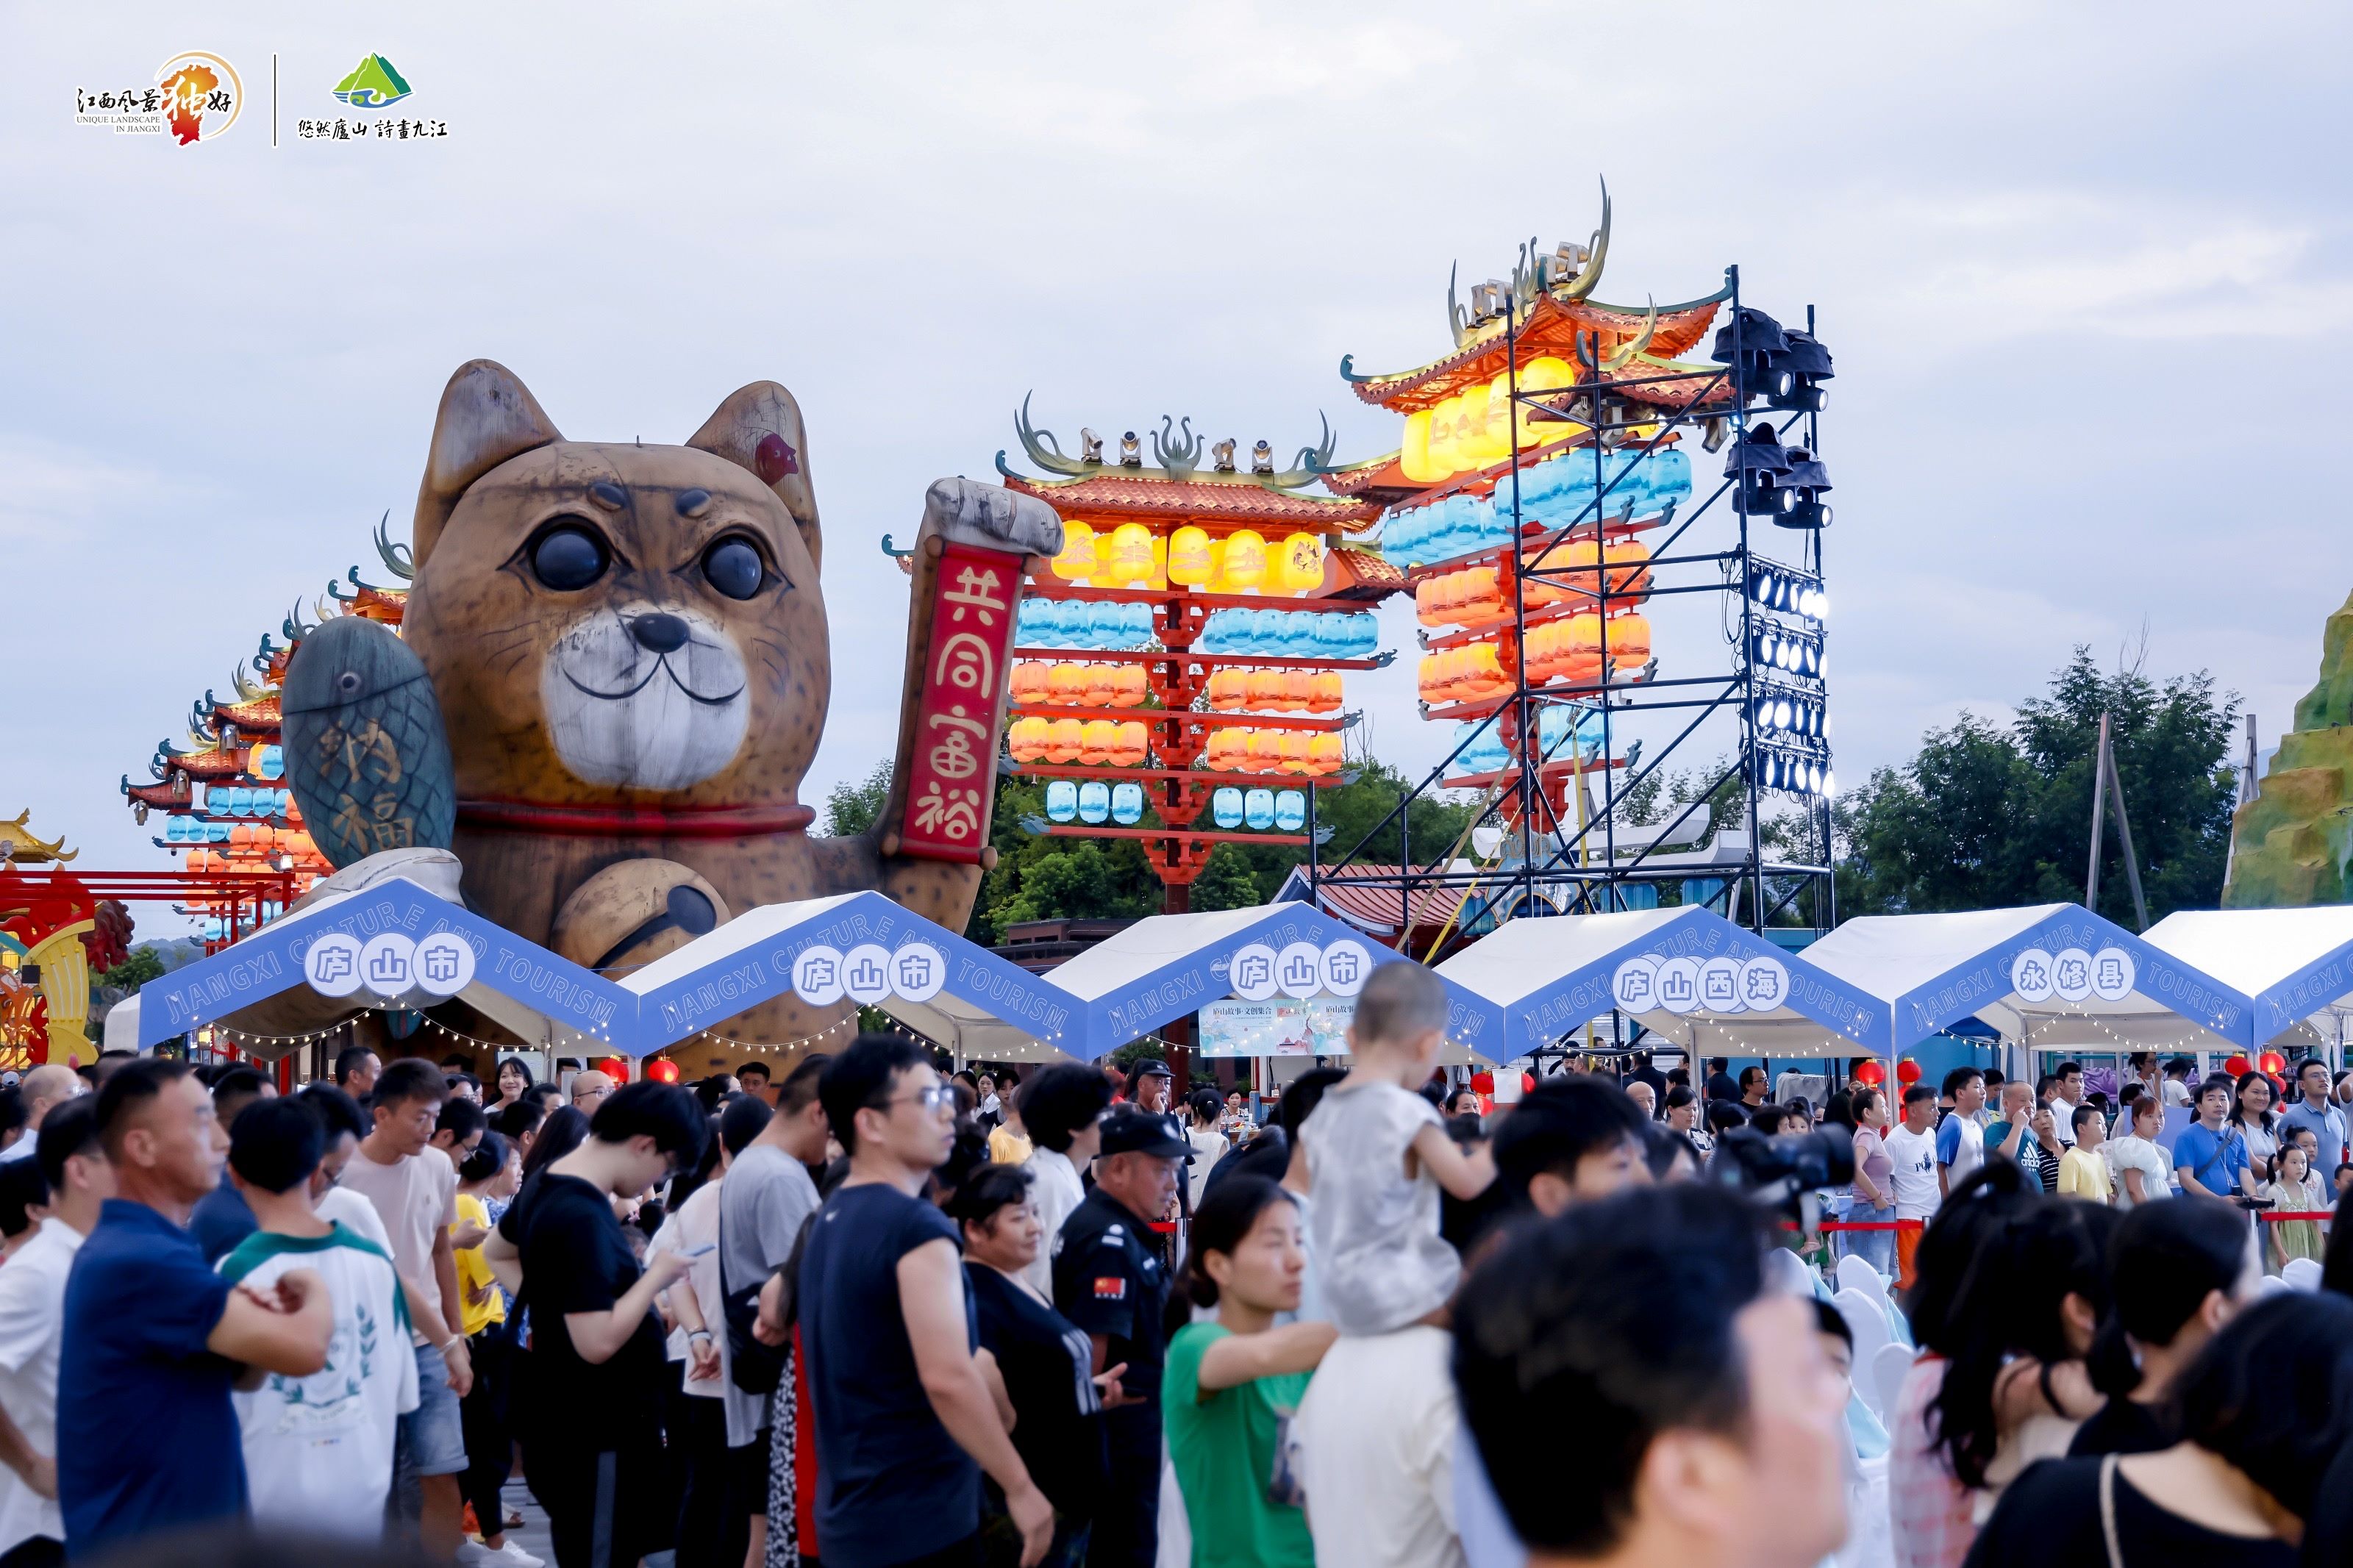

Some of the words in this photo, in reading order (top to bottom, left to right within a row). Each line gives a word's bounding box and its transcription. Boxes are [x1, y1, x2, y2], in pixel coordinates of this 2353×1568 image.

[915, 565, 1005, 839] 共同富裕
[165, 951, 282, 1025] JIANGXI
[289, 901, 425, 964] CTURE
[495, 948, 617, 1024] TOURISM
[315, 945, 459, 983] 庐山市
[660, 962, 766, 1033] JIANGXI
[772, 914, 895, 974] CTURE
[958, 958, 1068, 1031] TOURISM
[801, 955, 931, 993] 庐山市
[1238, 952, 1357, 990] 庐山市
[1620, 967, 1778, 1002] 庐山西海
[1912, 966, 1994, 1032] JIANGXI
[1998, 923, 2095, 979] CTURE
[2148, 962, 2240, 1029] TOURISM
[2019, 959, 2124, 990] 永修县
[1109, 967, 1204, 1037] JIANGXI
[1524, 973, 1612, 1041] JIANGXI
[1785, 967, 1874, 1033] OURISM
[2269, 964, 2343, 1028] JIANGXI
[2021, 1158, 2040, 1168] adida
